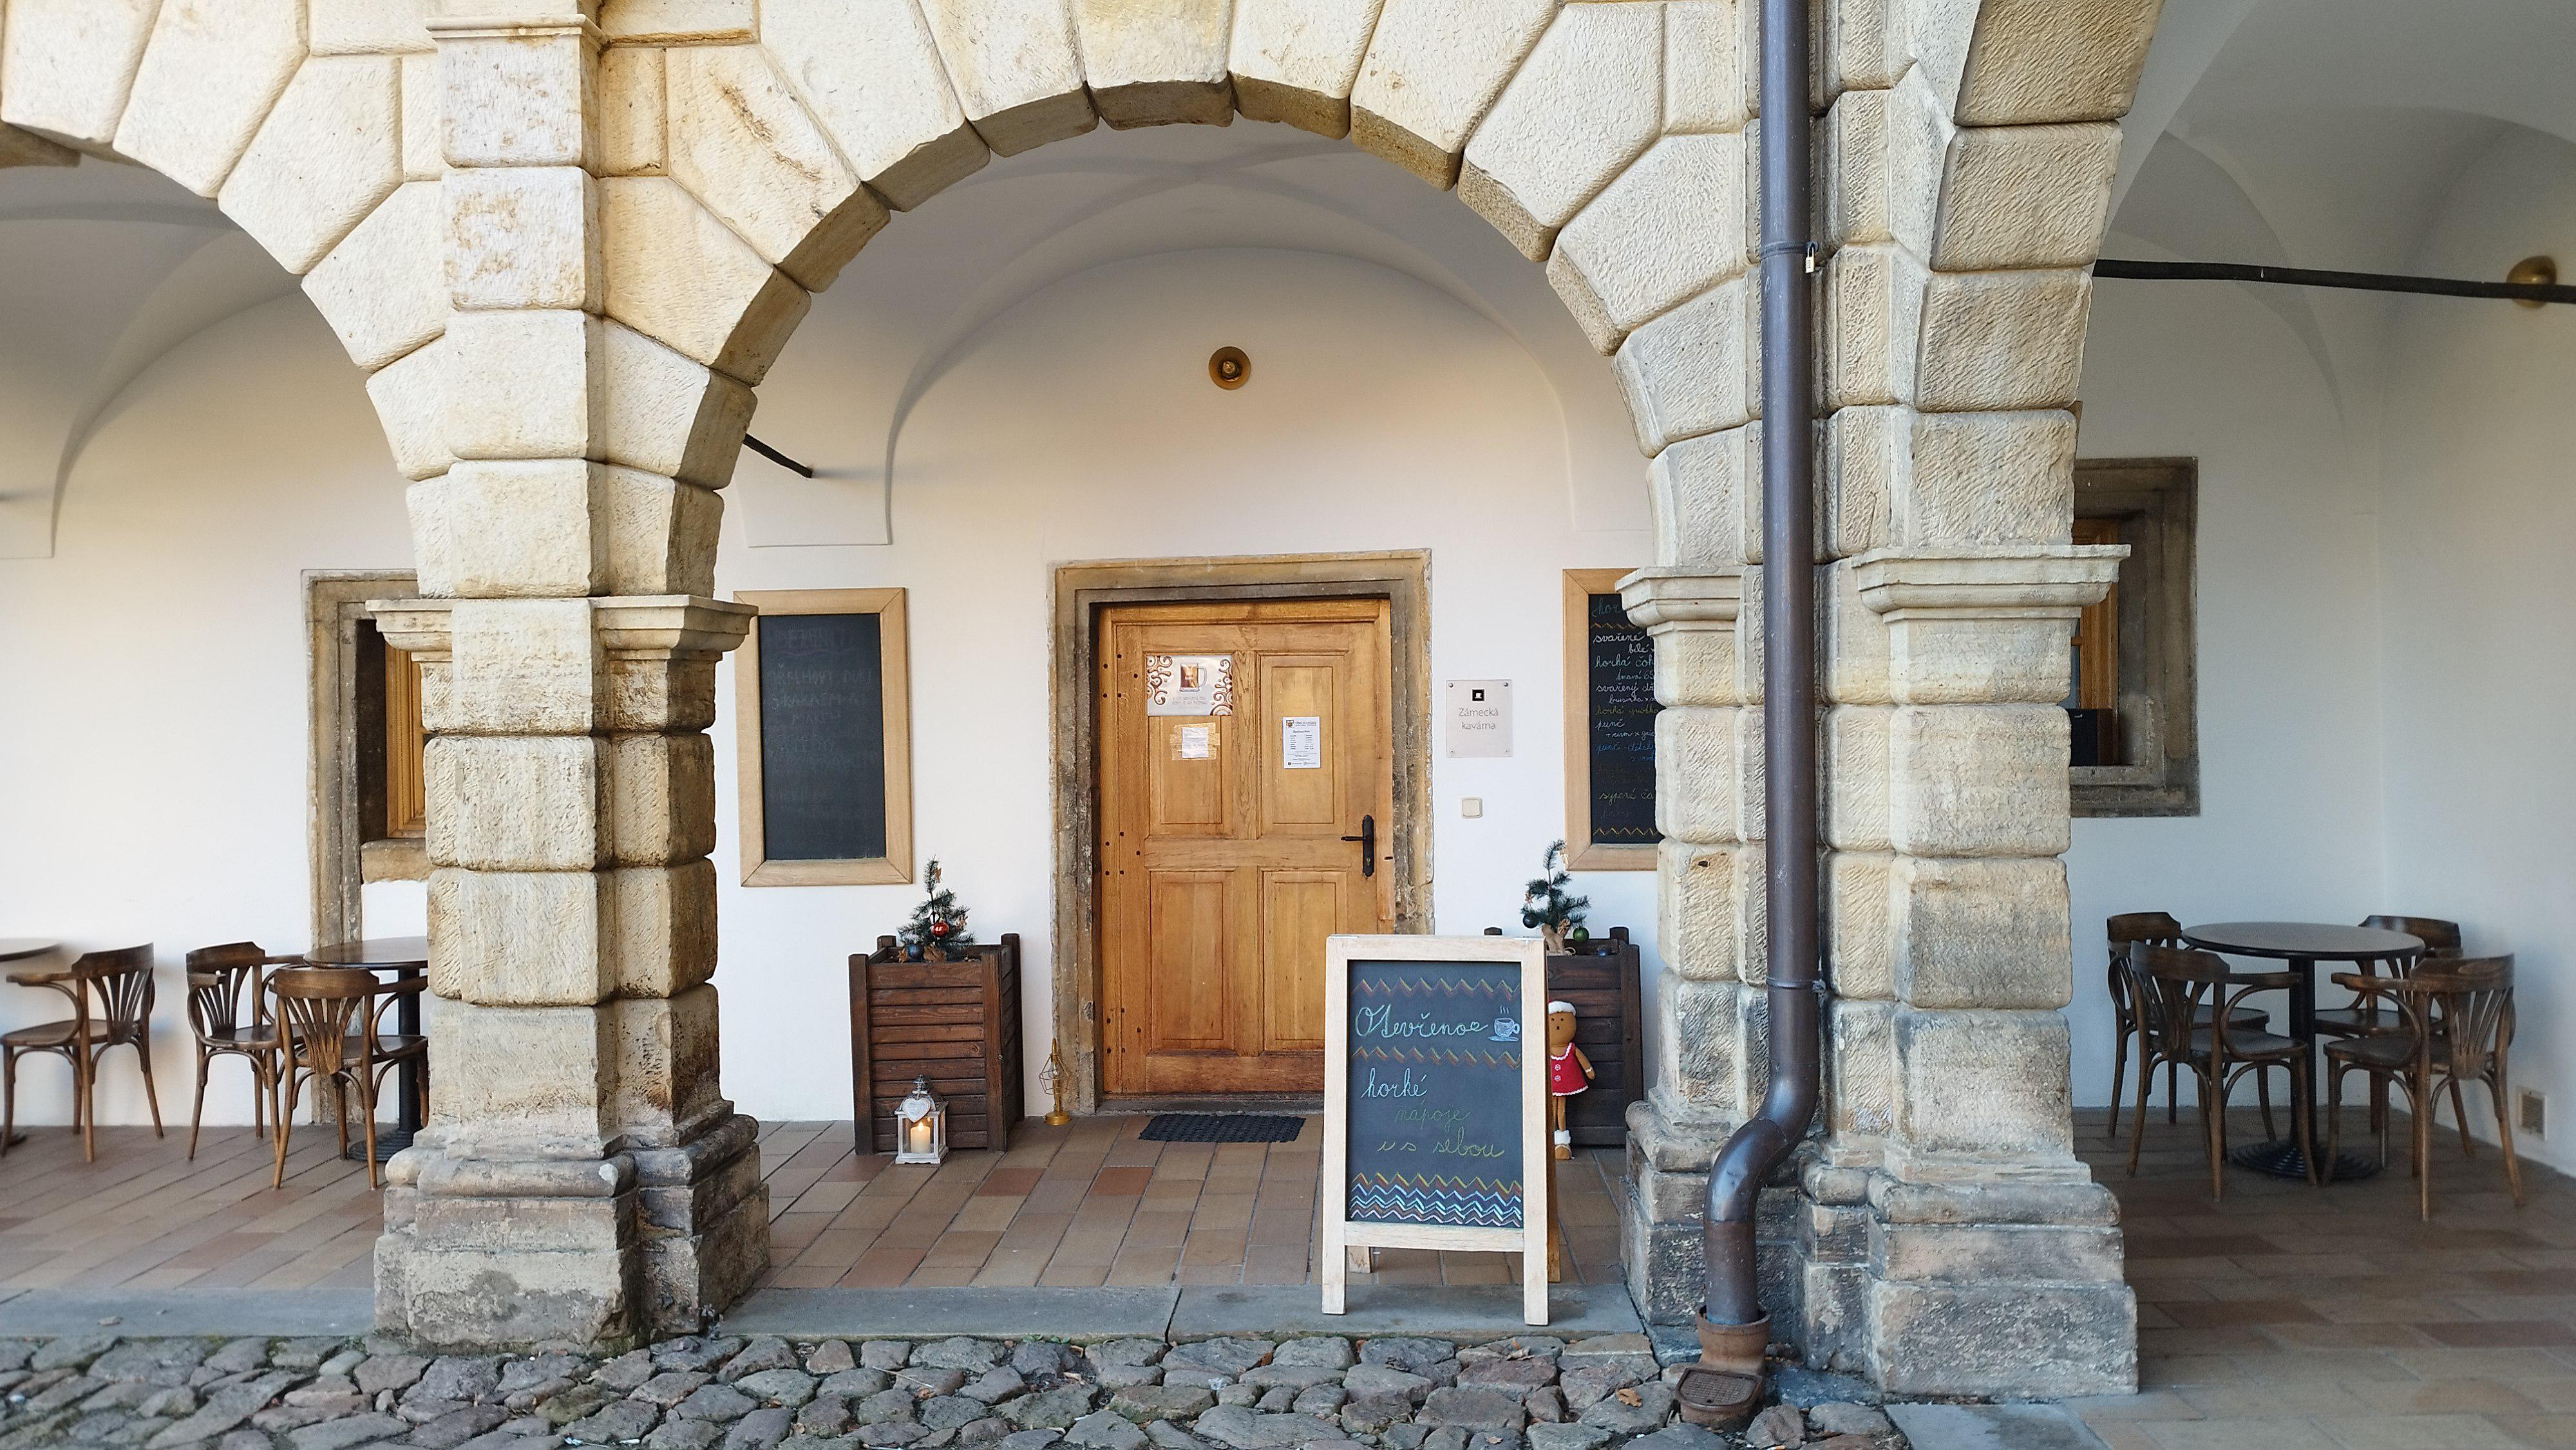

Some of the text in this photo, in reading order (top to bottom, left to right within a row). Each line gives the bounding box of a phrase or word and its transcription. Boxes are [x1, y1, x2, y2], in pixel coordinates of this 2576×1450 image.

[1593, 631, 1645, 643] svařené
[1595, 681, 1640, 698] svařený
[1458, 708, 1499, 717] Zámecká
[1461, 721, 1496, 730] kavárna
[1354, 1003, 1489, 1039] Otevřeno
[1360, 1067, 1428, 1098] horké
[1394, 1097, 1471, 1134] nápoje
[1432, 1126, 1505, 1158] sebou
